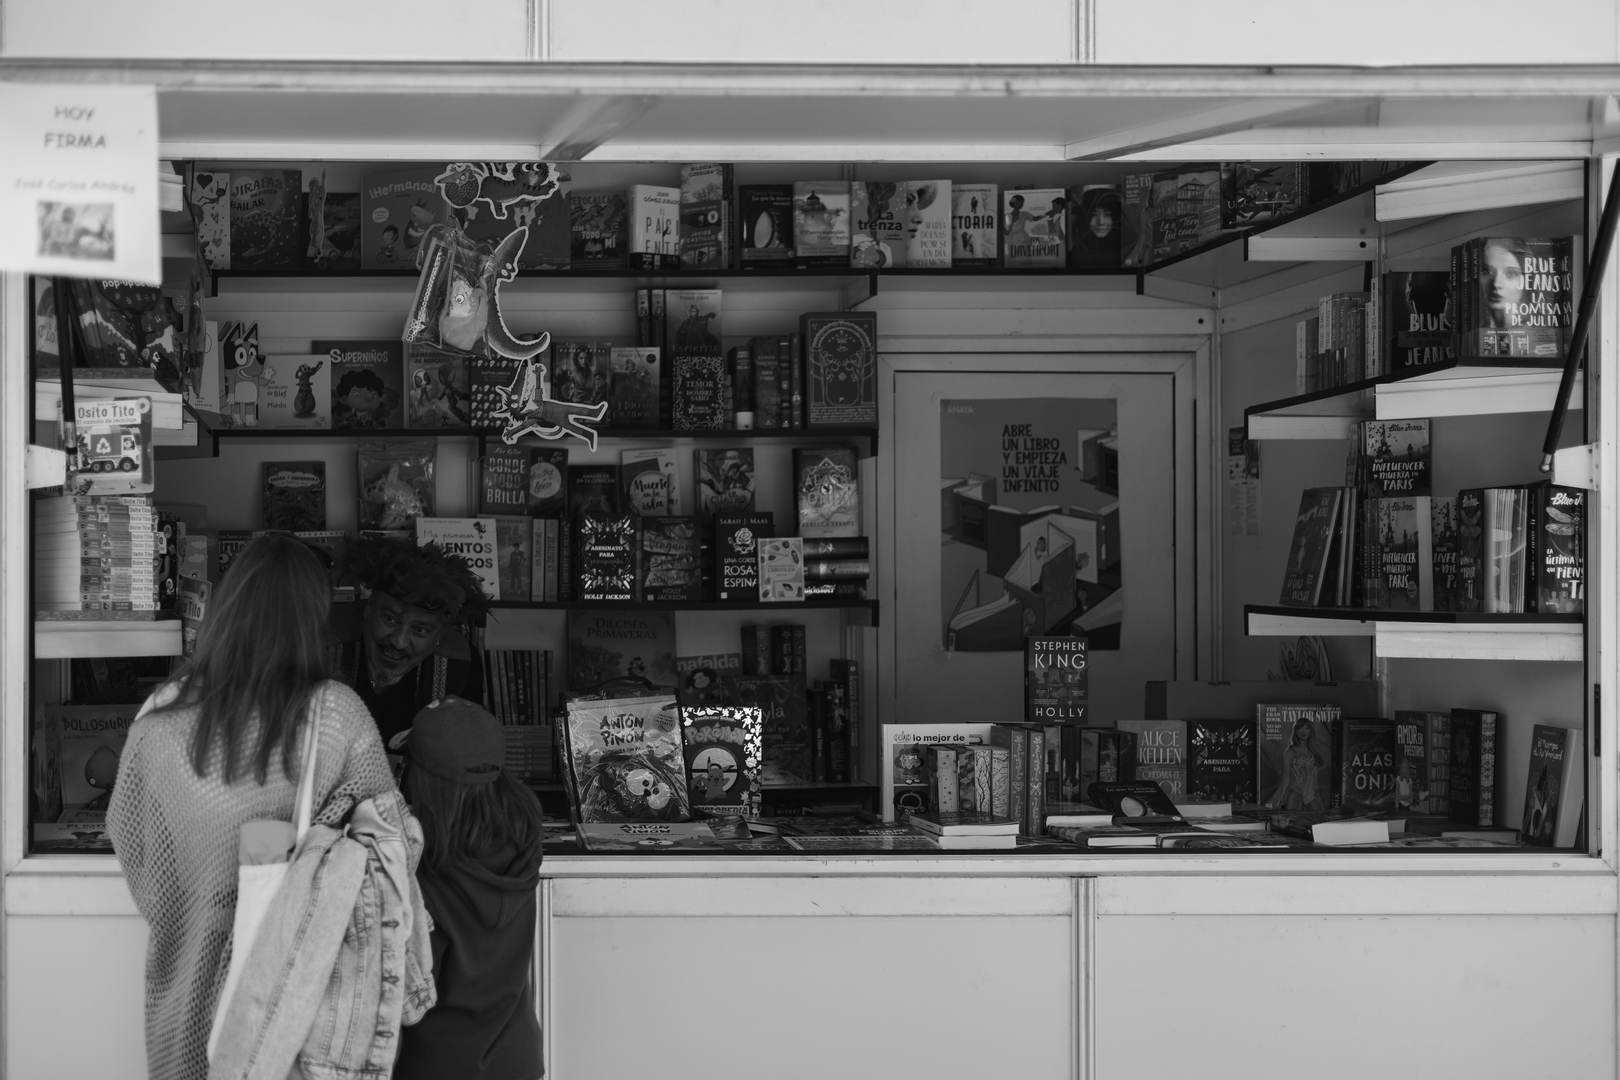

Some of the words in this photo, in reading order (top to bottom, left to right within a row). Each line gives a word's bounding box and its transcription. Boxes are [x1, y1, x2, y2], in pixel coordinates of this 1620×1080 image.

[54, 105, 96, 121] HOY
[44, 133, 107, 149] FIRMA
[231, 177, 284, 197] JIRAFAS
[230, 199, 265, 211] BAILAR
[879, 210, 894, 220] La
[858, 218, 903, 231] trenza
[952, 215, 994, 230] CTORIA
[687, 235, 716, 243] CASTILLO
[920, 230, 946, 238] DUEÑAS
[920, 240, 938, 248] POR
[1010, 244, 1060, 259] DAVENPORT
[1524, 257, 1556, 273] BLUE
[1517, 274, 1560, 292] JEANS
[1532, 292, 1545, 304] LA
[1505, 303, 1561, 315] PROMESA
[1408, 313, 1450, 332] BLUE
[1511, 315, 1523, 326] DE
[1526, 315, 1558, 327] JULIA
[672, 344, 717, 353] ESPÍRITU
[1405, 347, 1455, 366] JEANS
[78, 406, 107, 419] Osito
[112, 405, 135, 418] Tito
[1002, 424, 1033, 437] ABRE
[1387, 424, 1404, 432] Blue
[1002, 438, 1019, 451] UN
[1023, 438, 1060, 451] LIBRO
[1003, 452, 1010, 465] Y
[1015, 452, 1067, 465] EMPIEZA
[489, 458, 526, 474] DONDE
[1003, 466, 1019, 478] UN
[1024, 466, 1060, 478] VIAJE
[1372, 461, 1425, 472] INFLUENCER
[492, 473, 521, 488] TODO
[1379, 471, 1410, 480] MUERTA
[634, 478, 669, 492] Muerte
[1003, 480, 1059, 493] INFINITO
[486, 488, 526, 504] BRILLA
[1550, 493, 1574, 506] Blue
[642, 498, 664, 511] isla
[446, 543, 493, 554] ENTOS
[1382, 552, 1417, 563] INFLUENCER
[1546, 555, 1575, 565] ÚLTIMA
[1386, 564, 1407, 574] MUERTA
[724, 578, 757, 588] ESPINA
[596, 618, 648, 629] DIECISÉIS
[587, 628, 658, 640] PRIMAVERAS
[1034, 641, 1085, 651] STEPHEN
[1034, 653, 1087, 669] KING
[763, 701, 785, 724] yla
[1035, 707, 1085, 718] HOLLY
[1282, 710, 1315, 723] TAYLOR
[1315, 710, 1342, 723] SWIFT
[600, 713, 644, 730] ANTÓN
[913, 734, 921, 742] lo
[923, 734, 951, 743] mejor
[953, 734, 965, 742] de
[1141, 731, 1180, 747] ALICE
[1397, 724, 1418, 745] AMOR
[1139, 747, 1182, 765] KELLEN
[1352, 753, 1393, 767] ALAS
